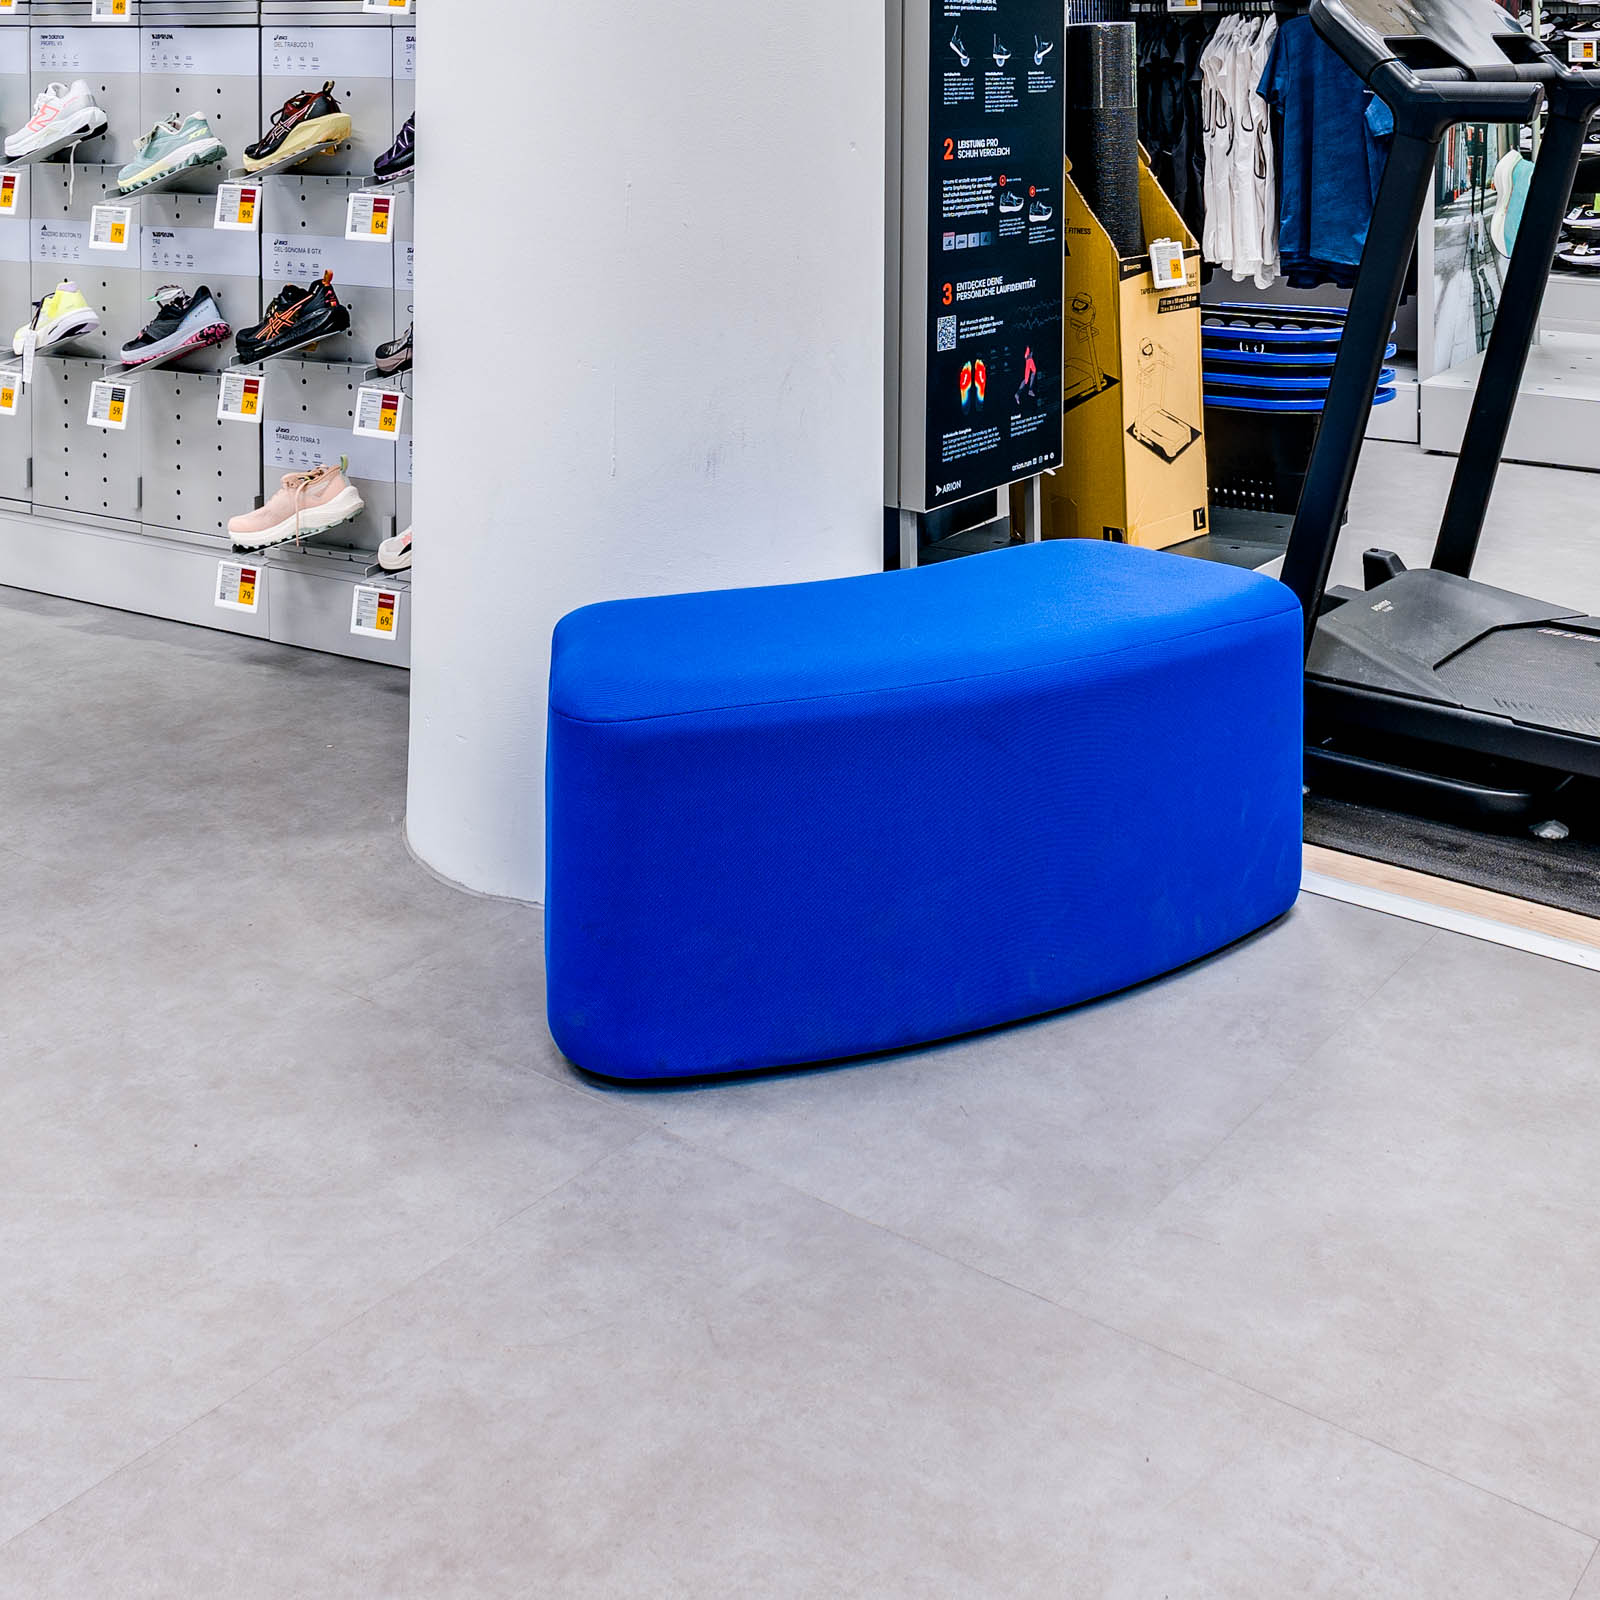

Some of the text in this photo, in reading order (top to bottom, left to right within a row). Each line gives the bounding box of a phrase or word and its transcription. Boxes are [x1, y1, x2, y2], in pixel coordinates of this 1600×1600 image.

[943, 138, 954, 160] 2
[957, 138, 999, 149] LEISTUNG PRO
[957, 147, 1010, 159] SCHUH VERGLEICH
[1069, 227, 1091, 235] FITNESS
[956, 276, 1003, 291] ENTDECKE DEINE
[942, 283, 953, 305] 3
[942, 480, 962, 494] ARION
